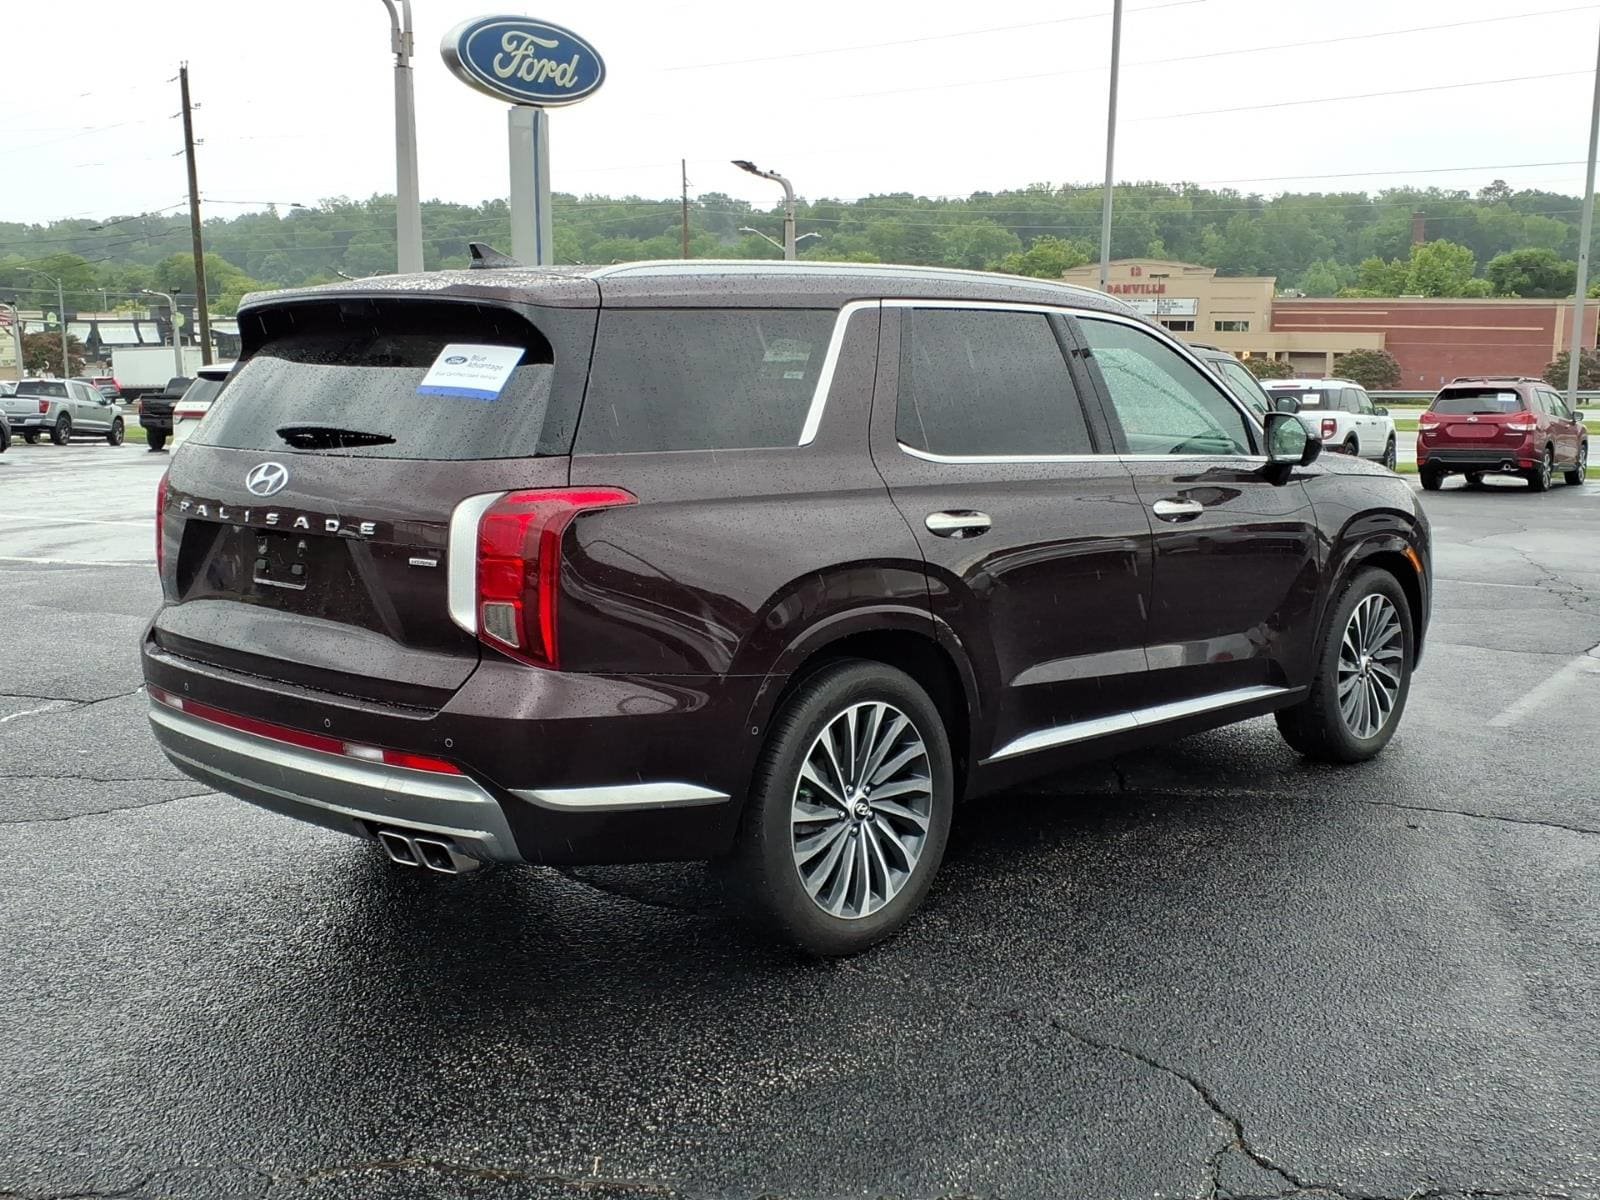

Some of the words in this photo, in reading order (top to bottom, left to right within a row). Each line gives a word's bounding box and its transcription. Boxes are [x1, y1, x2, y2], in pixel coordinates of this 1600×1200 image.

[493, 30, 580, 88] Ford
[1106, 283, 1166, 294] DANVILLE
[180, 500, 377, 536] PALISADE
